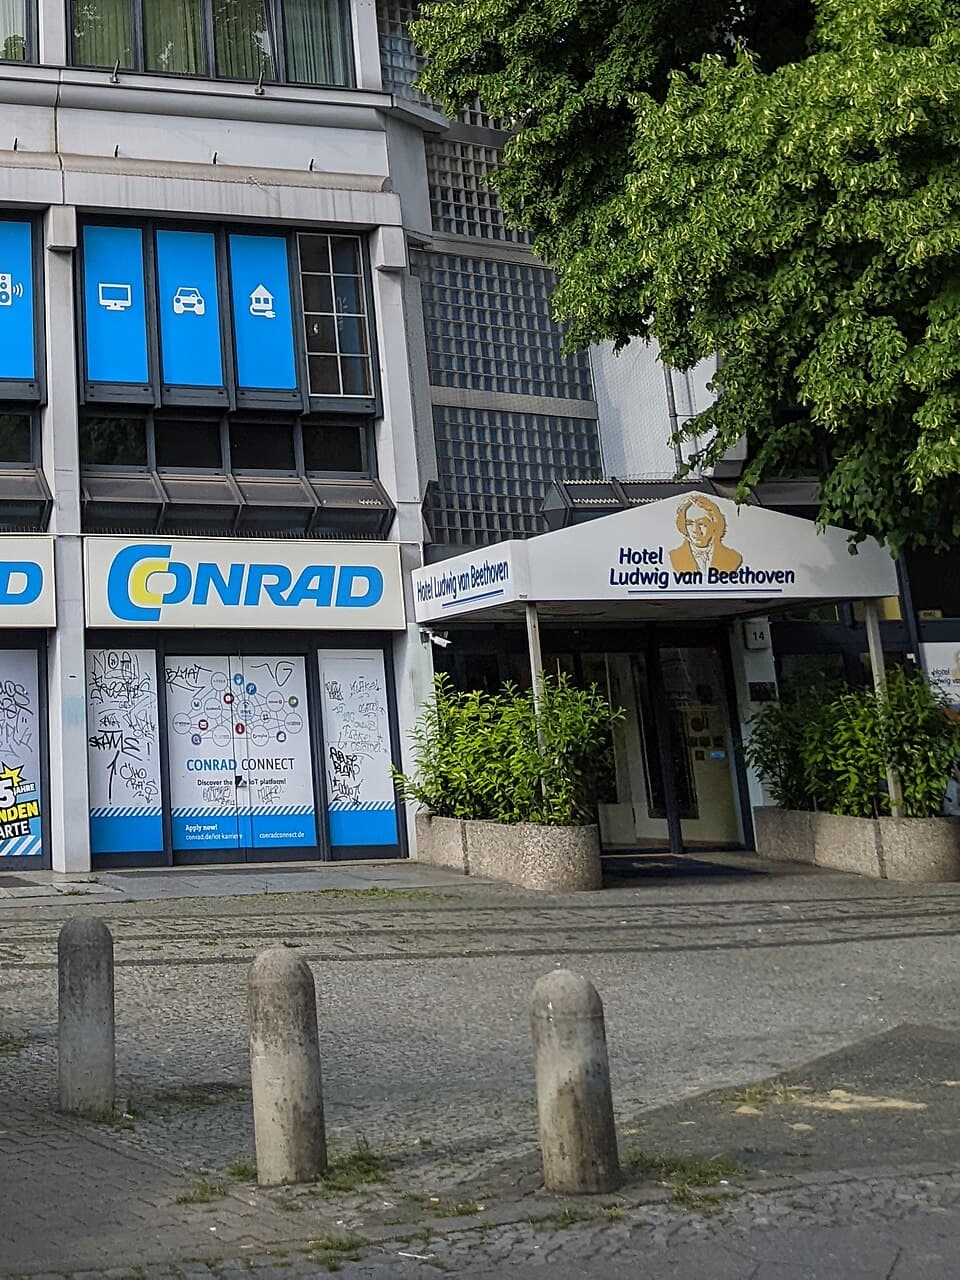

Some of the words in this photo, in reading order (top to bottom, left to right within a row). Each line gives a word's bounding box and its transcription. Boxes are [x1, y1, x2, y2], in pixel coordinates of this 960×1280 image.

[619, 546, 664, 565] Hotel
[107, 543, 385, 623] CONRAD
[417, 577, 433, 602] Hotel
[433, 570, 457, 599] Ludwig
[458, 572, 470, 592] van
[470, 560, 509, 589] Beethoven
[609, 567, 670, 589] Ludwig
[673, 572, 703, 585] van
[707, 566, 796, 585] Beethoven
[753, 631, 765, 641] 14
[186, 758, 238, 772] CONRAD
[241, 757, 296, 771] CONNECT
[197, 778, 222, 786] Discover
[223, 778, 233, 786] the
[259, 777, 287, 787] platform!
[14, 783, 36, 796] JAHRE
[185, 824, 202, 833] Apply
[202, 823, 218, 831] now!
[259, 831, 305, 839] conradconnect.de
